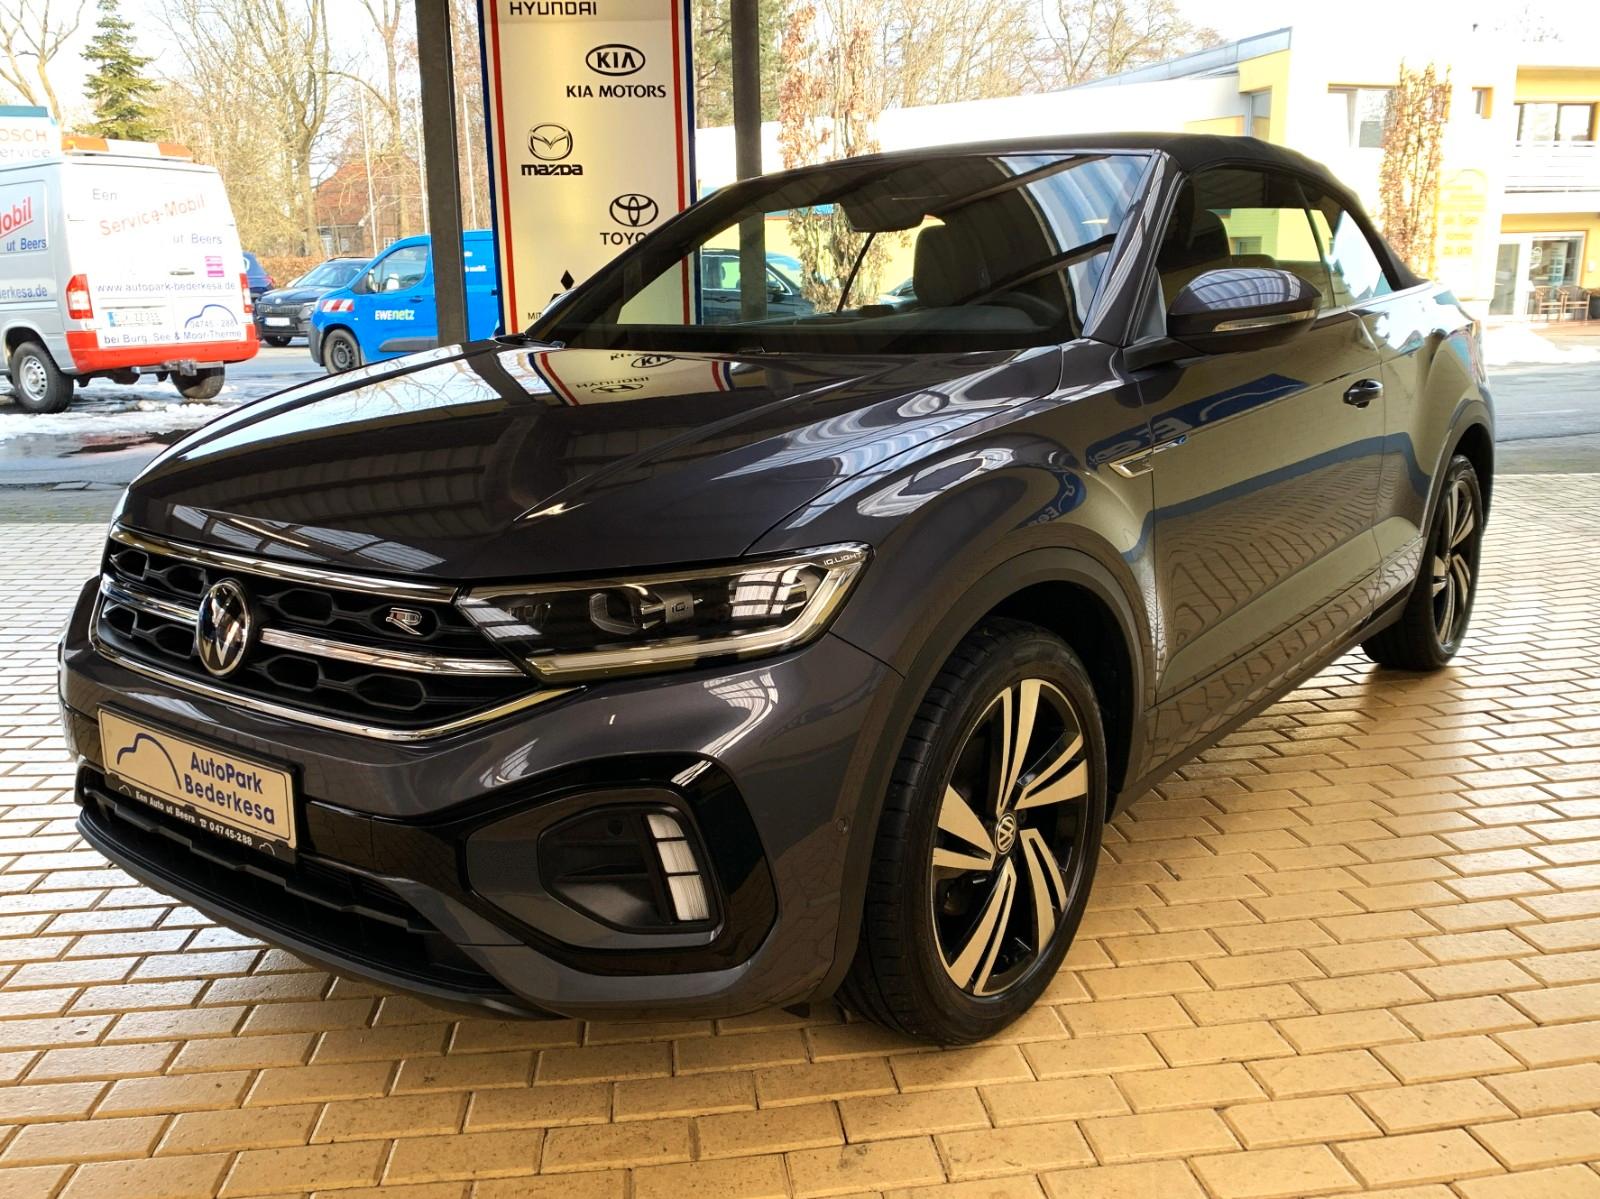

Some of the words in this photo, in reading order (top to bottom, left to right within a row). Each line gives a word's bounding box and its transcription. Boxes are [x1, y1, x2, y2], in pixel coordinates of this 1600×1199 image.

[509, 1, 597, 15] HYUNDAI
[596, 51, 636, 69] KIA
[566, 85, 593, 98] KIA
[599, 84, 667, 98] MOTORS
[521, 164, 584, 176] mazda
[92, 188, 118, 201] Een
[99, 193, 206, 236] Service-Mobil
[7, 240, 16, 251] ut
[21, 238, 47, 250] Beers
[0, 283, 48, 300] erkesa.de
[375, 309, 415, 321] EWEnetz
[190, 752, 263, 794] AutoPark
[184, 773, 275, 825] Bederkesa
[135, 790, 148, 803] Een
[149, 796, 164, 809] Auto
[166, 803, 173, 815] ut
[175, 808, 196, 824] Beers
[209, 818, 253, 846] 04745-288
